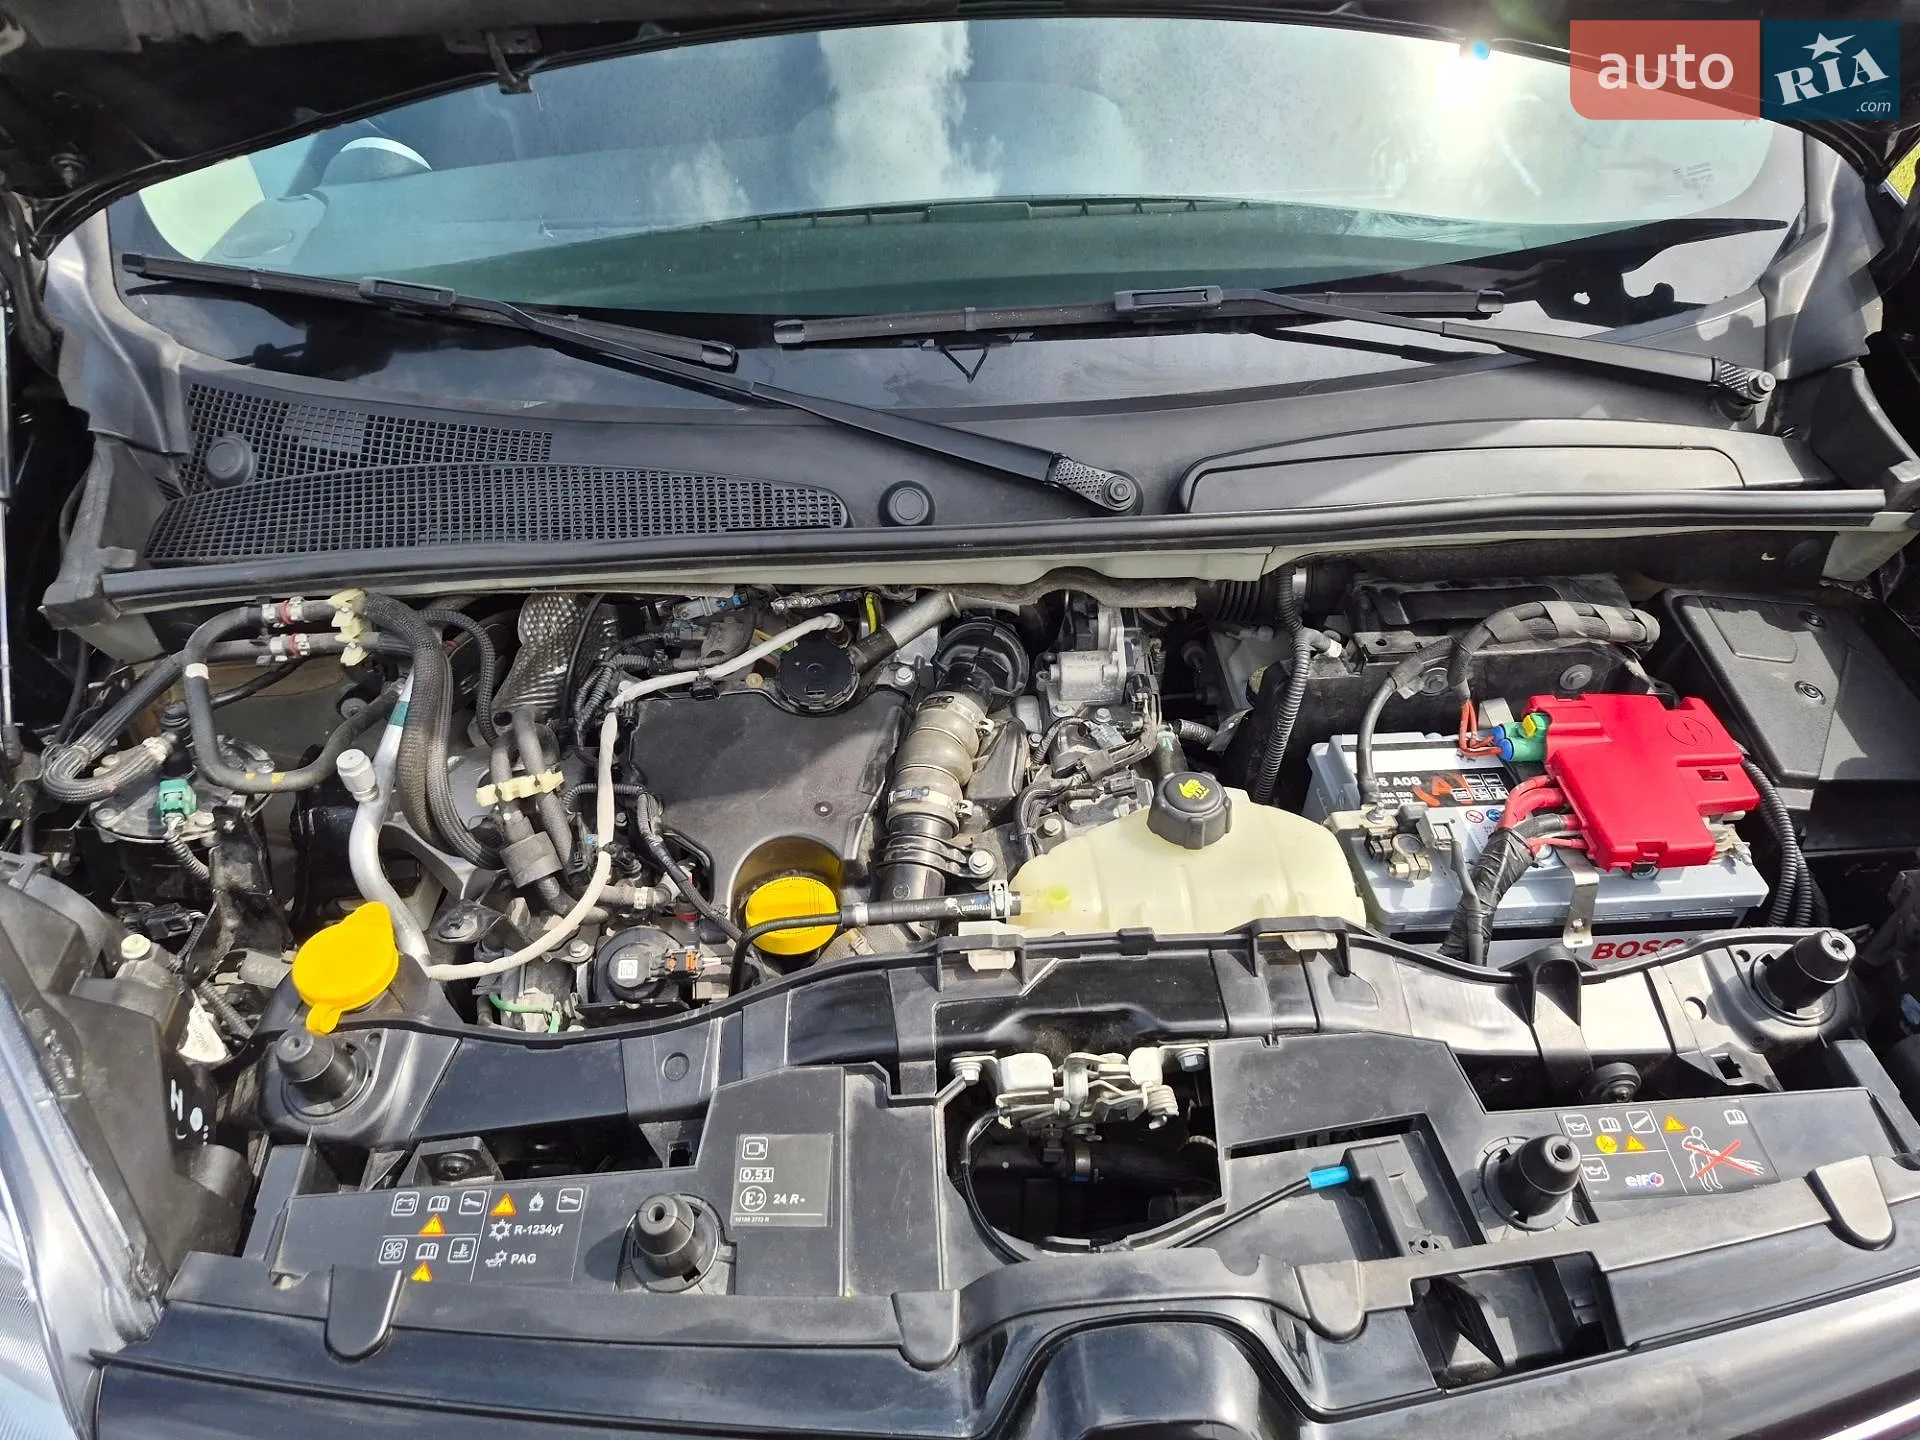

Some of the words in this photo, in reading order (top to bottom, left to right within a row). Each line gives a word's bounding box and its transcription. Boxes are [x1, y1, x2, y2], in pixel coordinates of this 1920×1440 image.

[1376, 777, 1389, 787] 5
[1392, 776, 1422, 786] A08
[773, 1194, 787, 1205] 24
[514, 1223, 564, 1237] R-1234yf
[510, 1253, 537, 1265] PAG
